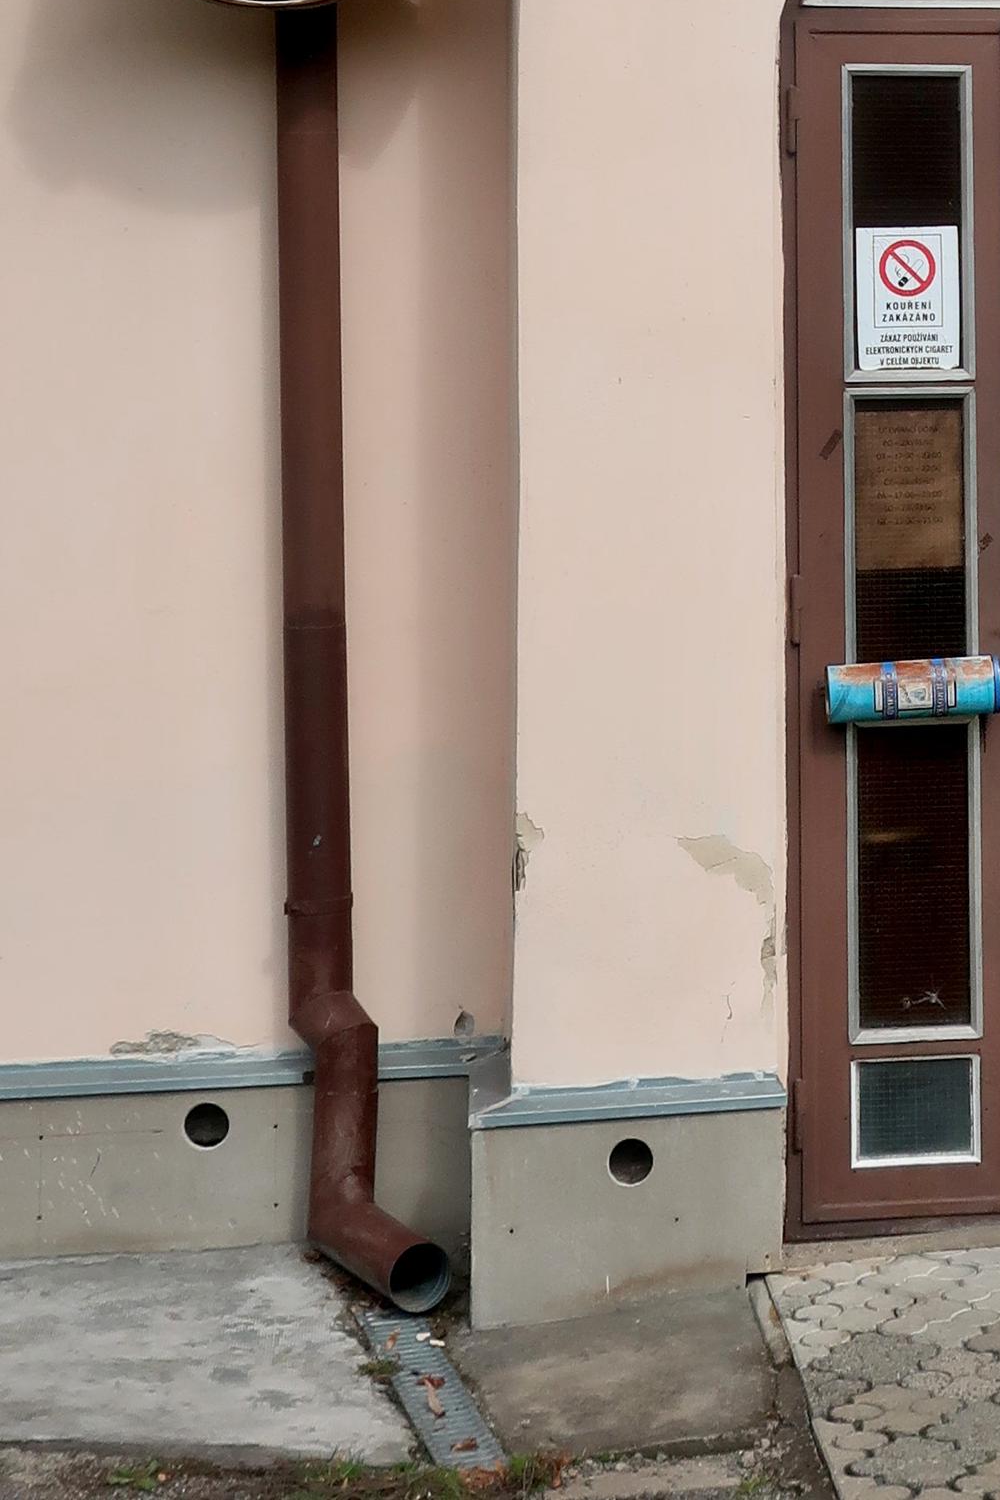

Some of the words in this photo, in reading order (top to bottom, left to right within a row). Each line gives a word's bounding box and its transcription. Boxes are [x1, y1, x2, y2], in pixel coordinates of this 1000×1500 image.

[925, 345, 953, 354] CIGARET
[880, 358, 885, 366] V
[910, 356, 939, 366] OBJEKTU
